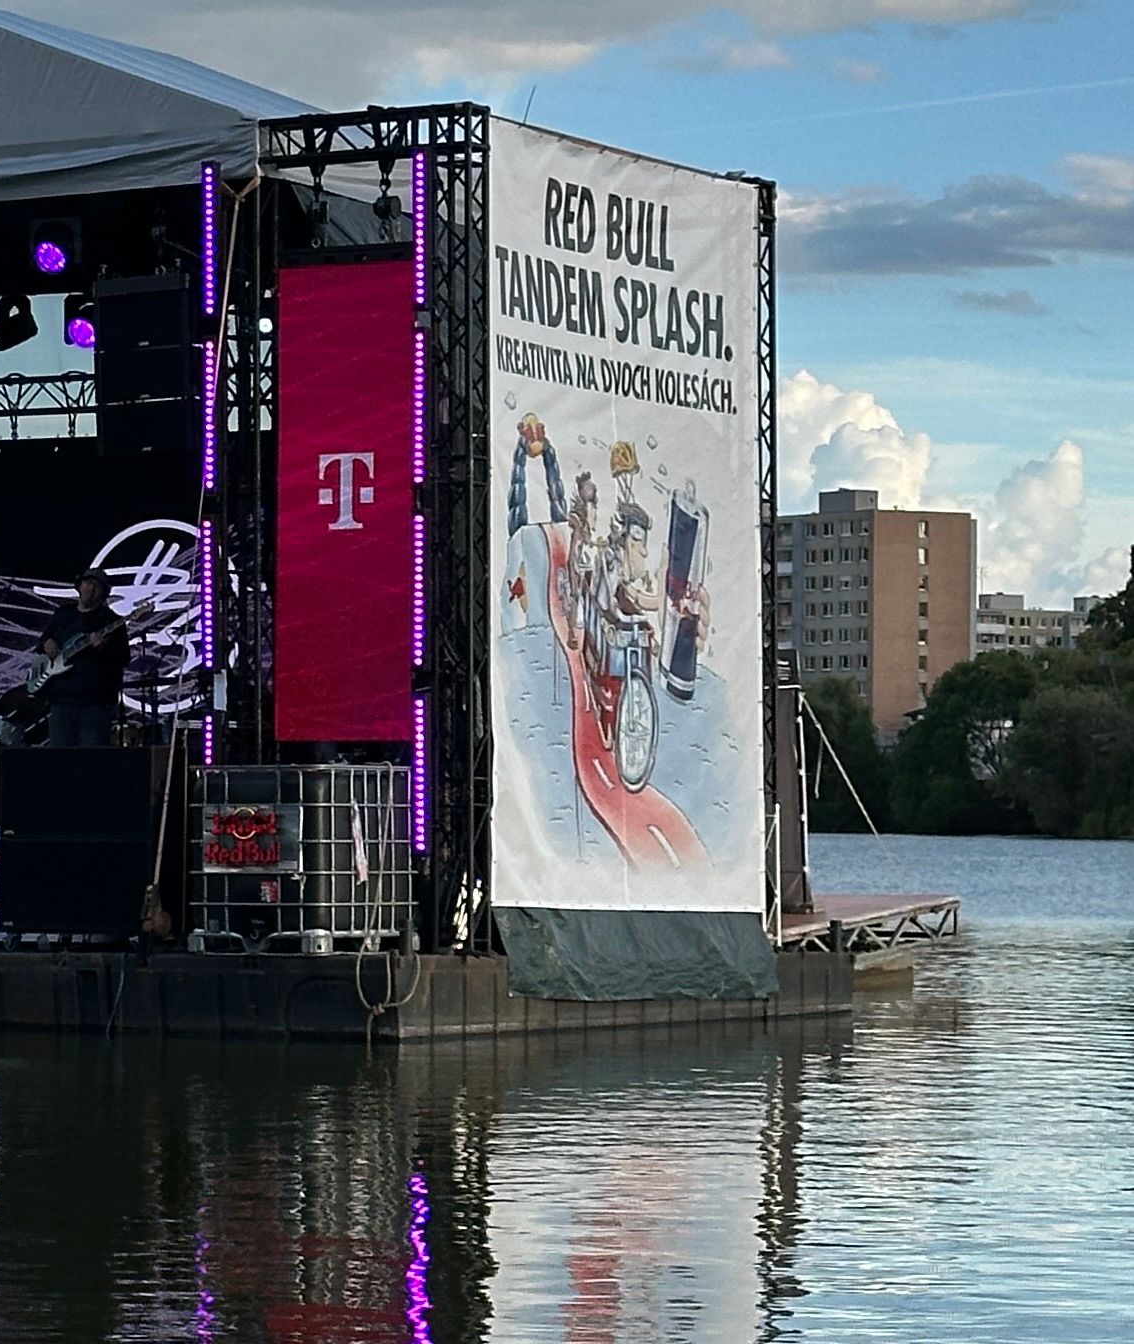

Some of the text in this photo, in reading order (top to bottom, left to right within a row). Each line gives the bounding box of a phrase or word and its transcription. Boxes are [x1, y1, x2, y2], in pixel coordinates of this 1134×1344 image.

[544, 177, 674, 271] RED BULL
[495, 245, 733, 362] TANDEM SPLASH.
[496, 334, 737, 415] KREATIVITA NA DVOCH KOLESÁCH.
[206, 842, 243, 863] Red
